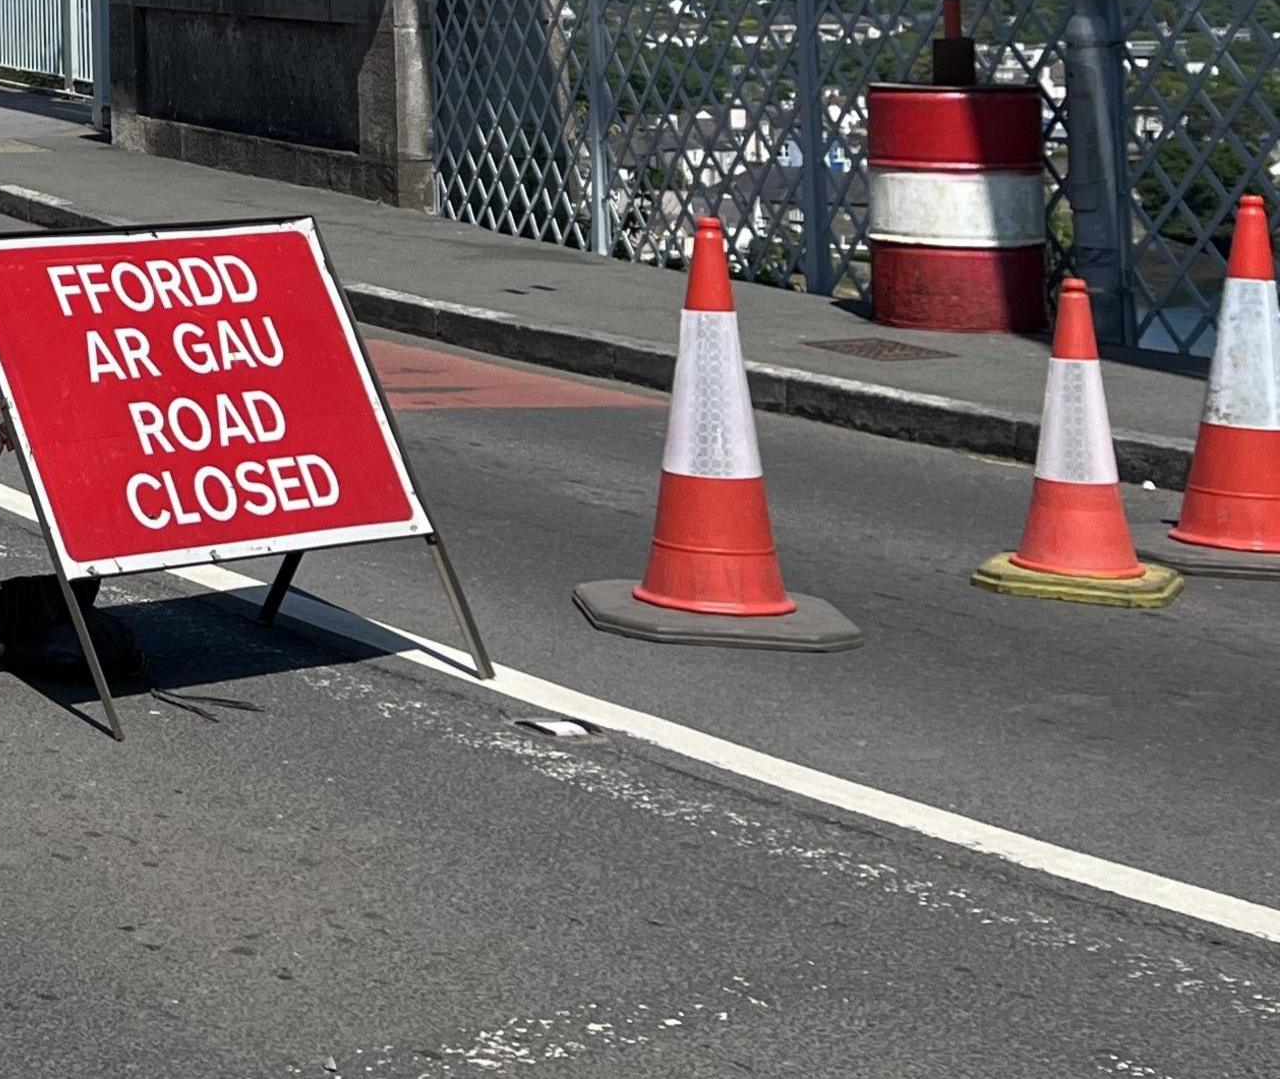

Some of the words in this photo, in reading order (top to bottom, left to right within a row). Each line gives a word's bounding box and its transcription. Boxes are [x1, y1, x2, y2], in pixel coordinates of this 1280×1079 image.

[46, 254, 259, 317] FFORDD
[85, 328, 162, 383] AR
[172, 316, 285, 374] GAU
[128, 389, 286, 456] ROAD
[125, 454, 340, 531] CLOSED
